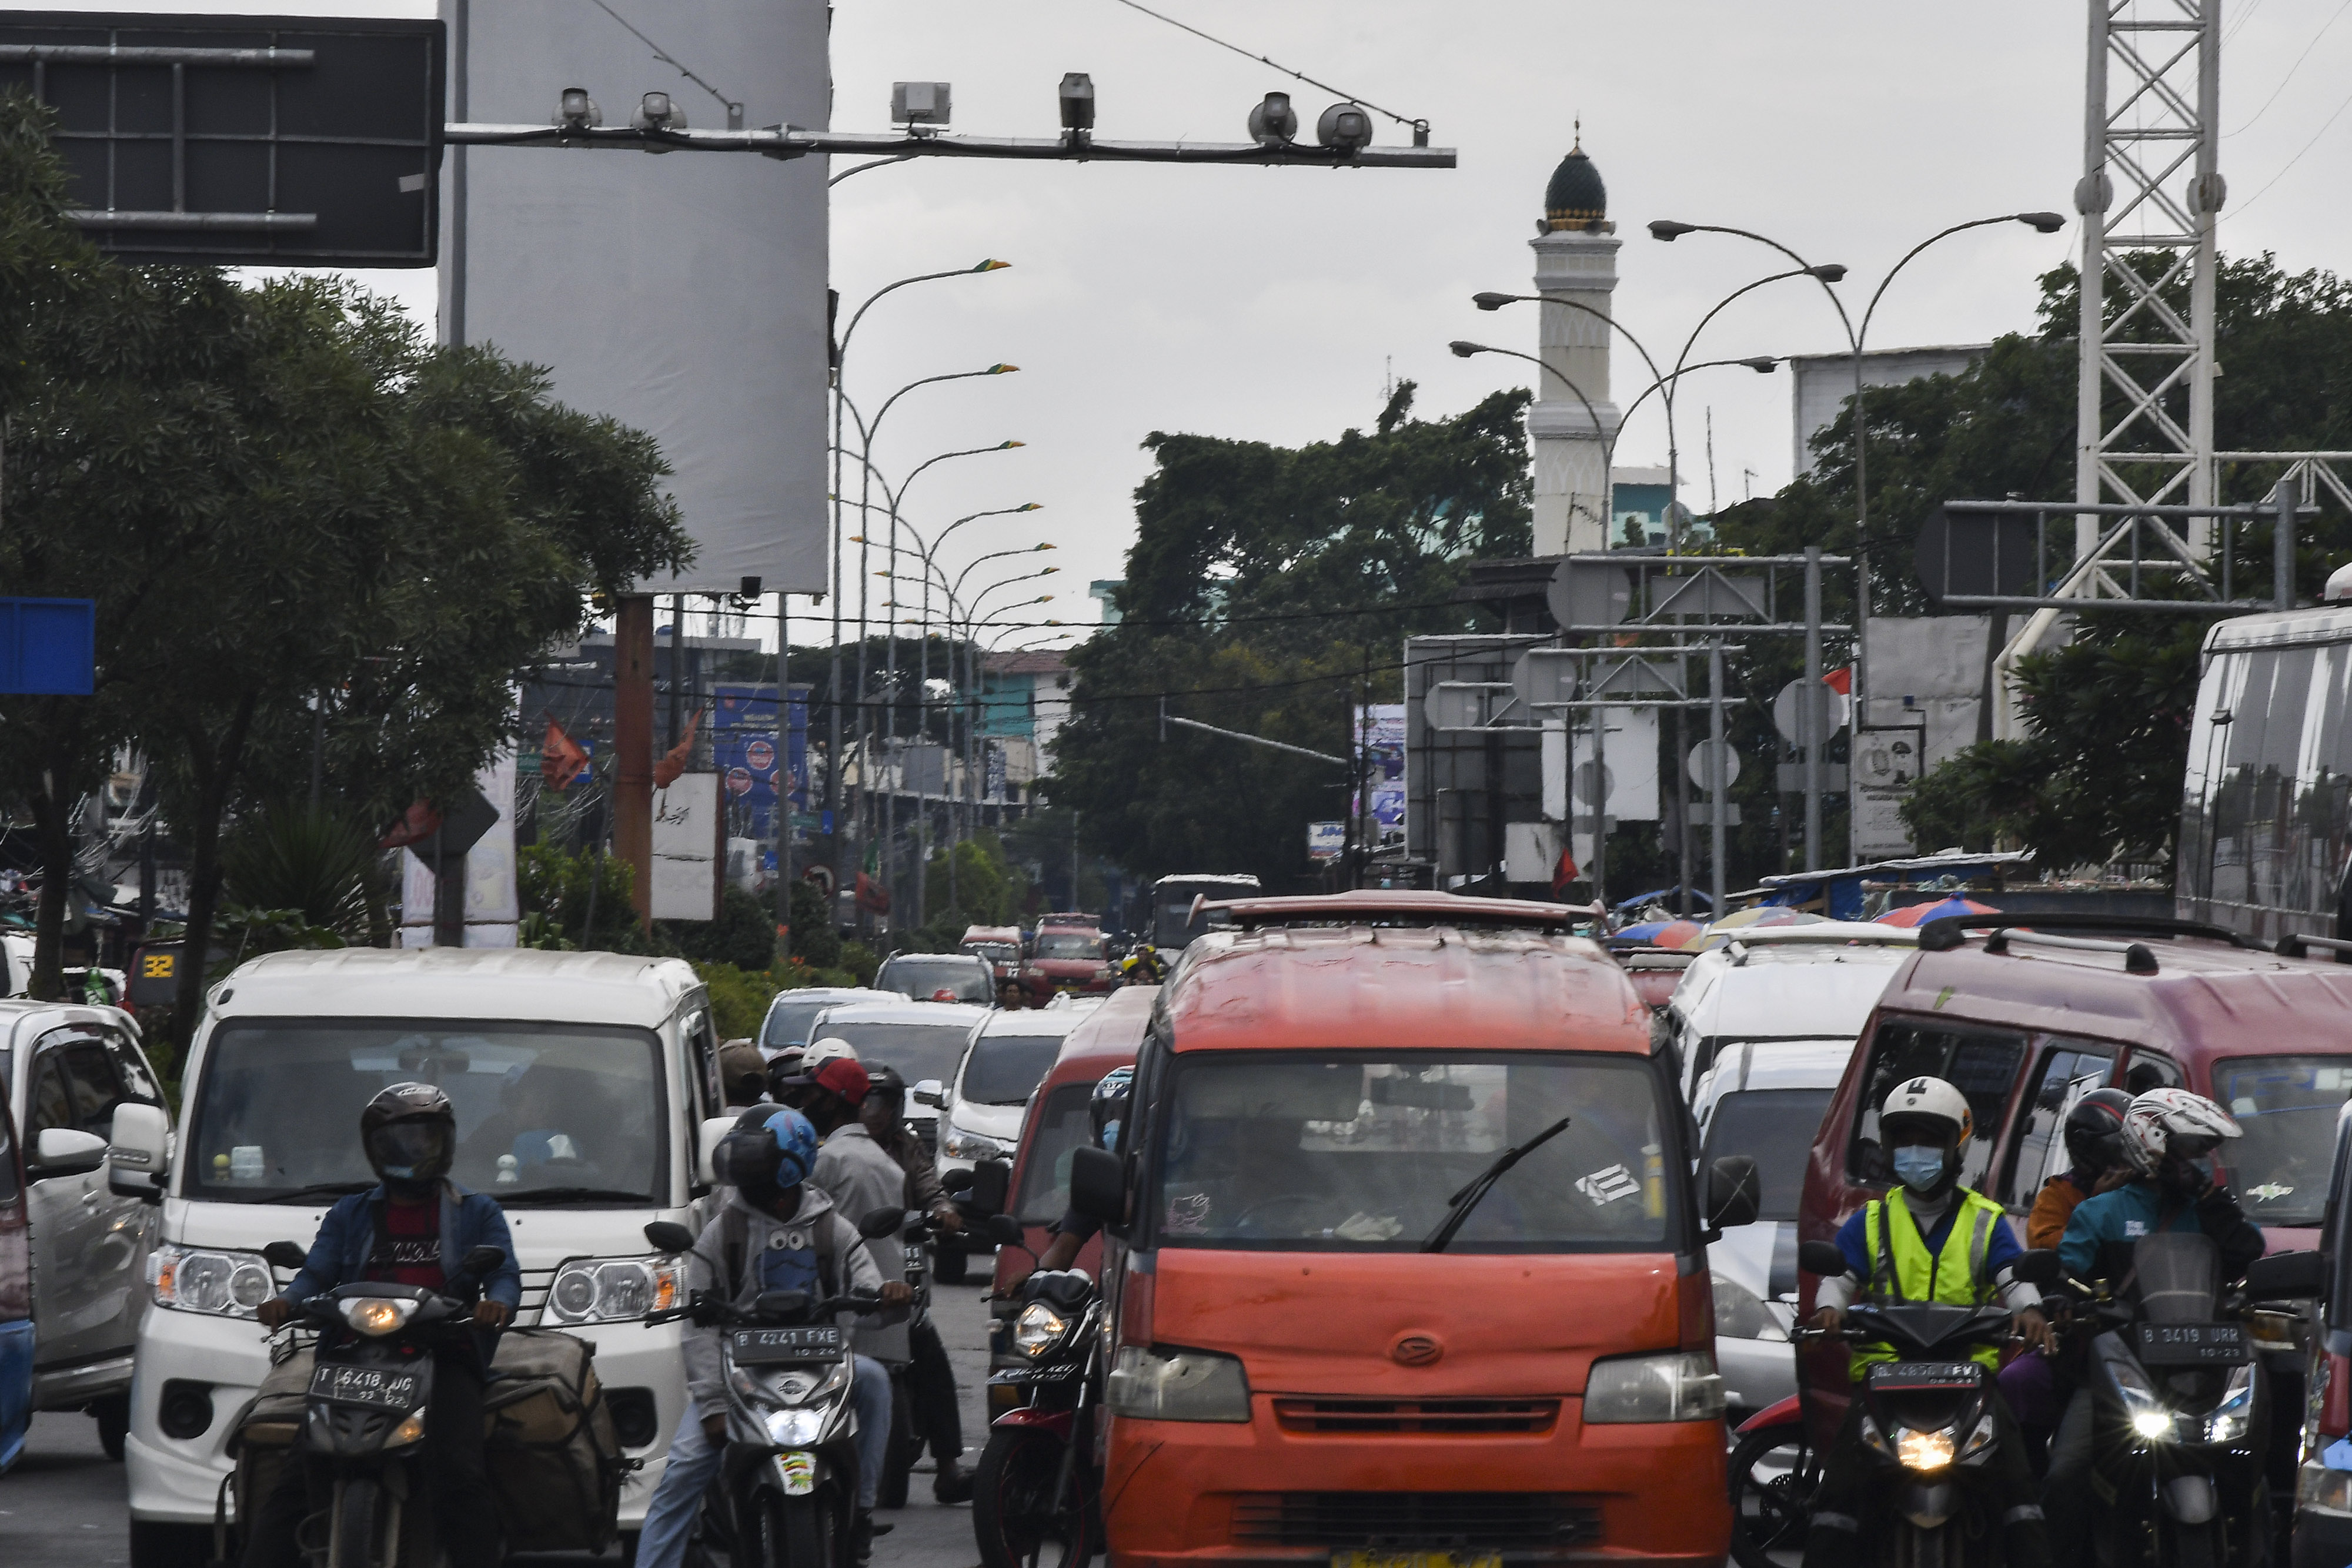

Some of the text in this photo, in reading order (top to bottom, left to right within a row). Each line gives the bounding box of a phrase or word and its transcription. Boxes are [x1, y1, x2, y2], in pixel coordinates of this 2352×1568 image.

[144, 955, 173, 977] 32
[738, 1330, 837, 1346] B 4241 FXE
[2146, 1329, 2153, 1342] B
[320, 1368, 330, 1382] T
[341, 1369, 382, 1387] 6418
